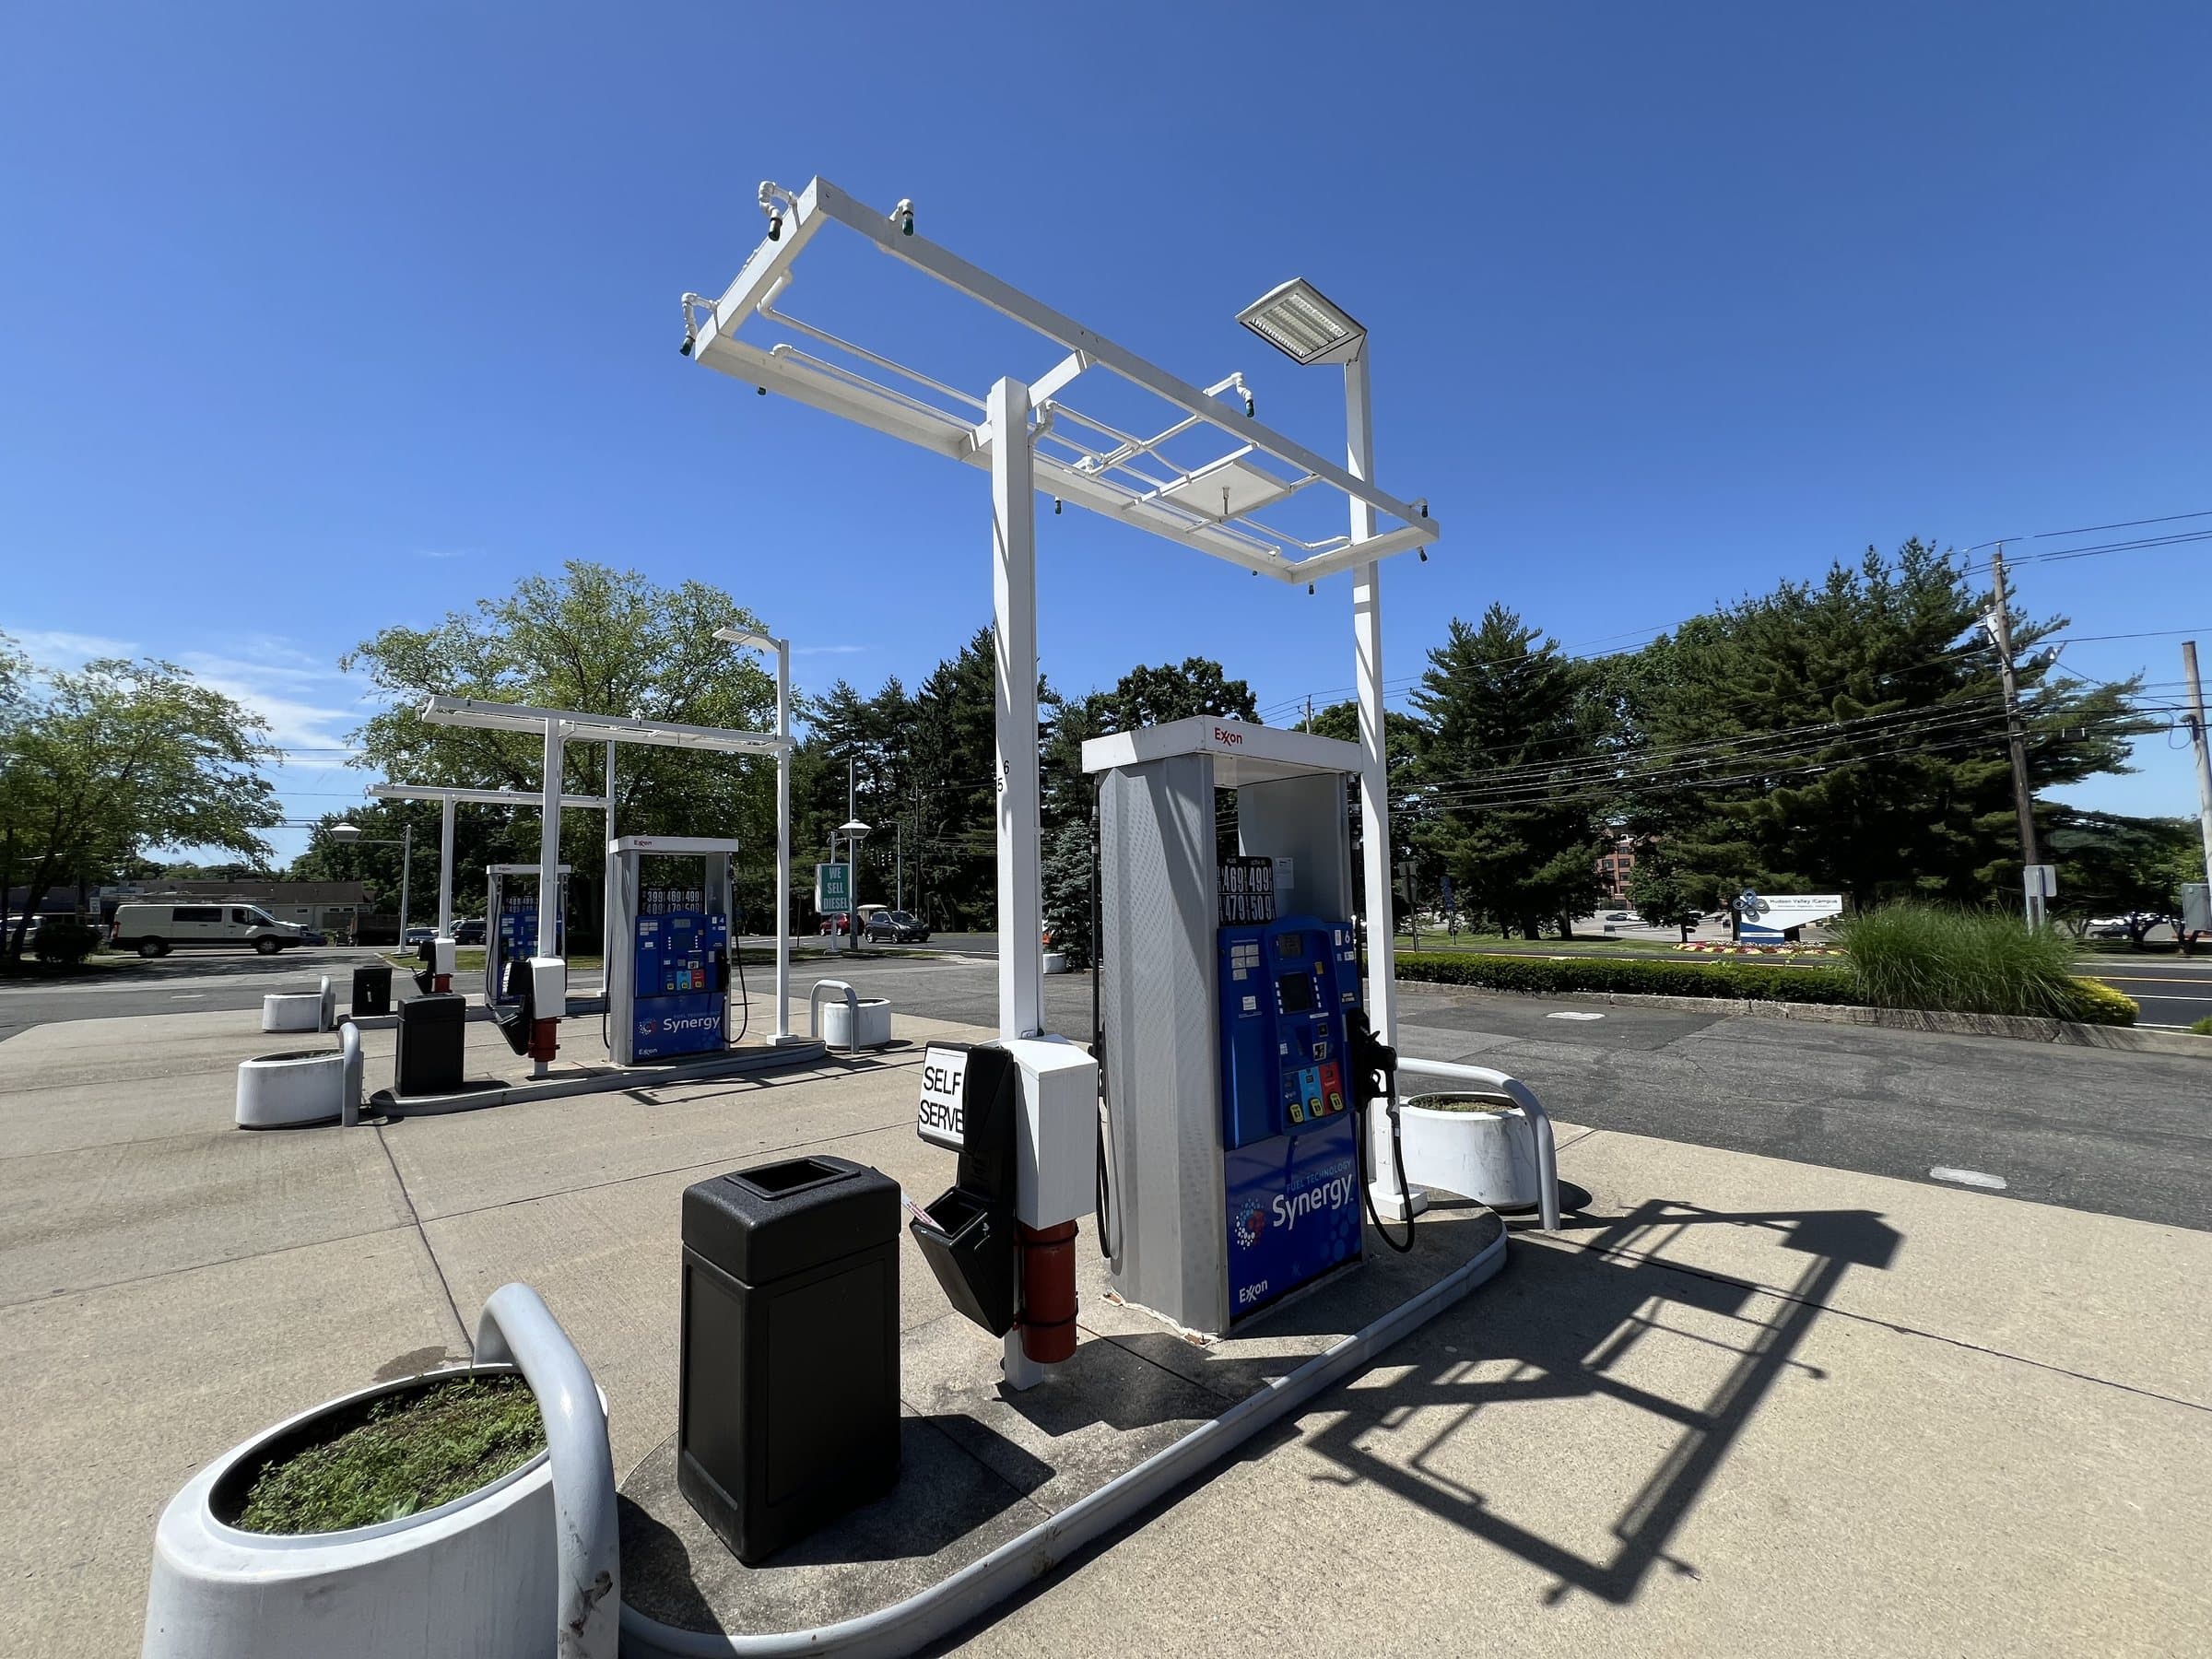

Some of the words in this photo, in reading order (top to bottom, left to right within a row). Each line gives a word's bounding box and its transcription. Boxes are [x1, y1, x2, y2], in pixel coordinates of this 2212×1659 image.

[1214, 726, 1242, 747] Exxon
[1004, 760, 1009, 775] 6
[998, 778, 1003, 793] 5
[830, 867, 841, 879] WE
[1223, 865, 1244, 893] 469
[1249, 866, 1269, 892] 499
[647, 890, 664, 902] 399
[828, 882, 843, 893] SELL
[824, 898, 847, 909] DIESEL
[1225, 895, 1246, 922] 479
[1345, 930, 1350, 944] 6
[663, 1016, 721, 1033] Synergy
[638, 1048, 658, 1056] Exxon
[924, 1065, 962, 1097] SELF
[920, 1099, 965, 1135] SERVE
[1286, 1180, 1304, 1193] FUEL
[1306, 1159, 1351, 1184] TECHNOLOGY
[1272, 1173, 1353, 1230] Synergy
[1239, 1278, 1268, 1303] Exxon
